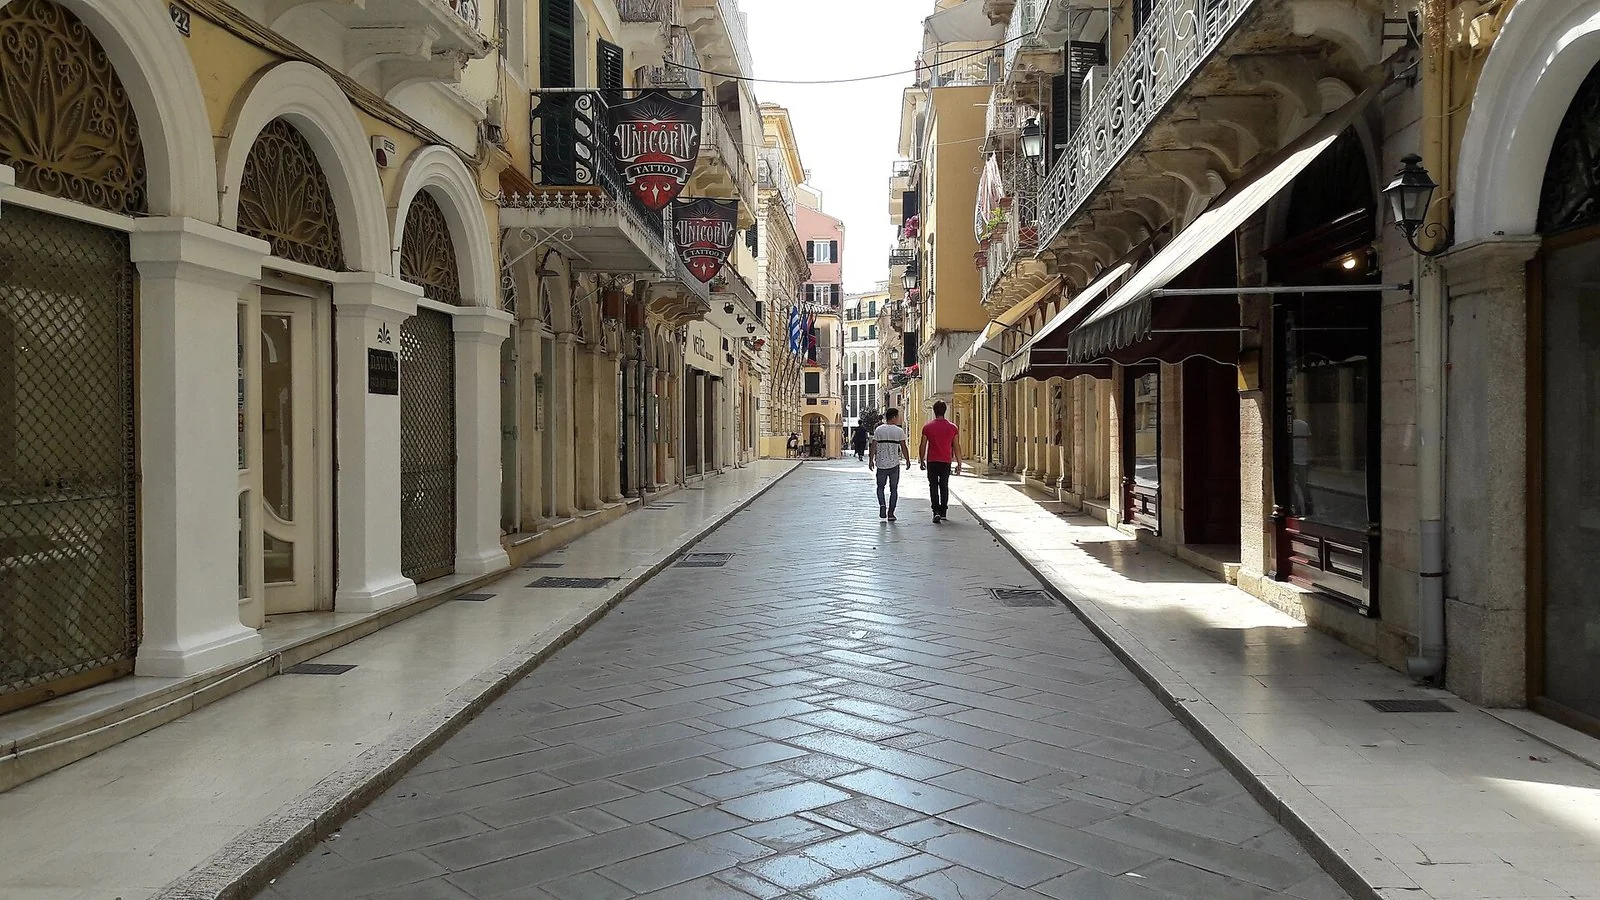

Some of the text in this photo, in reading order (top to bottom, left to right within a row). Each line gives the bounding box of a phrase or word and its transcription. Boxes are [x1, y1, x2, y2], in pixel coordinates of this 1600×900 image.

[174, 8, 188, 31] 22
[615, 123, 697, 159] UNICORN
[634, 163, 679, 176] TATTOO
[676, 220, 733, 246] UNICORN
[691, 249, 720, 257] TATTOO
